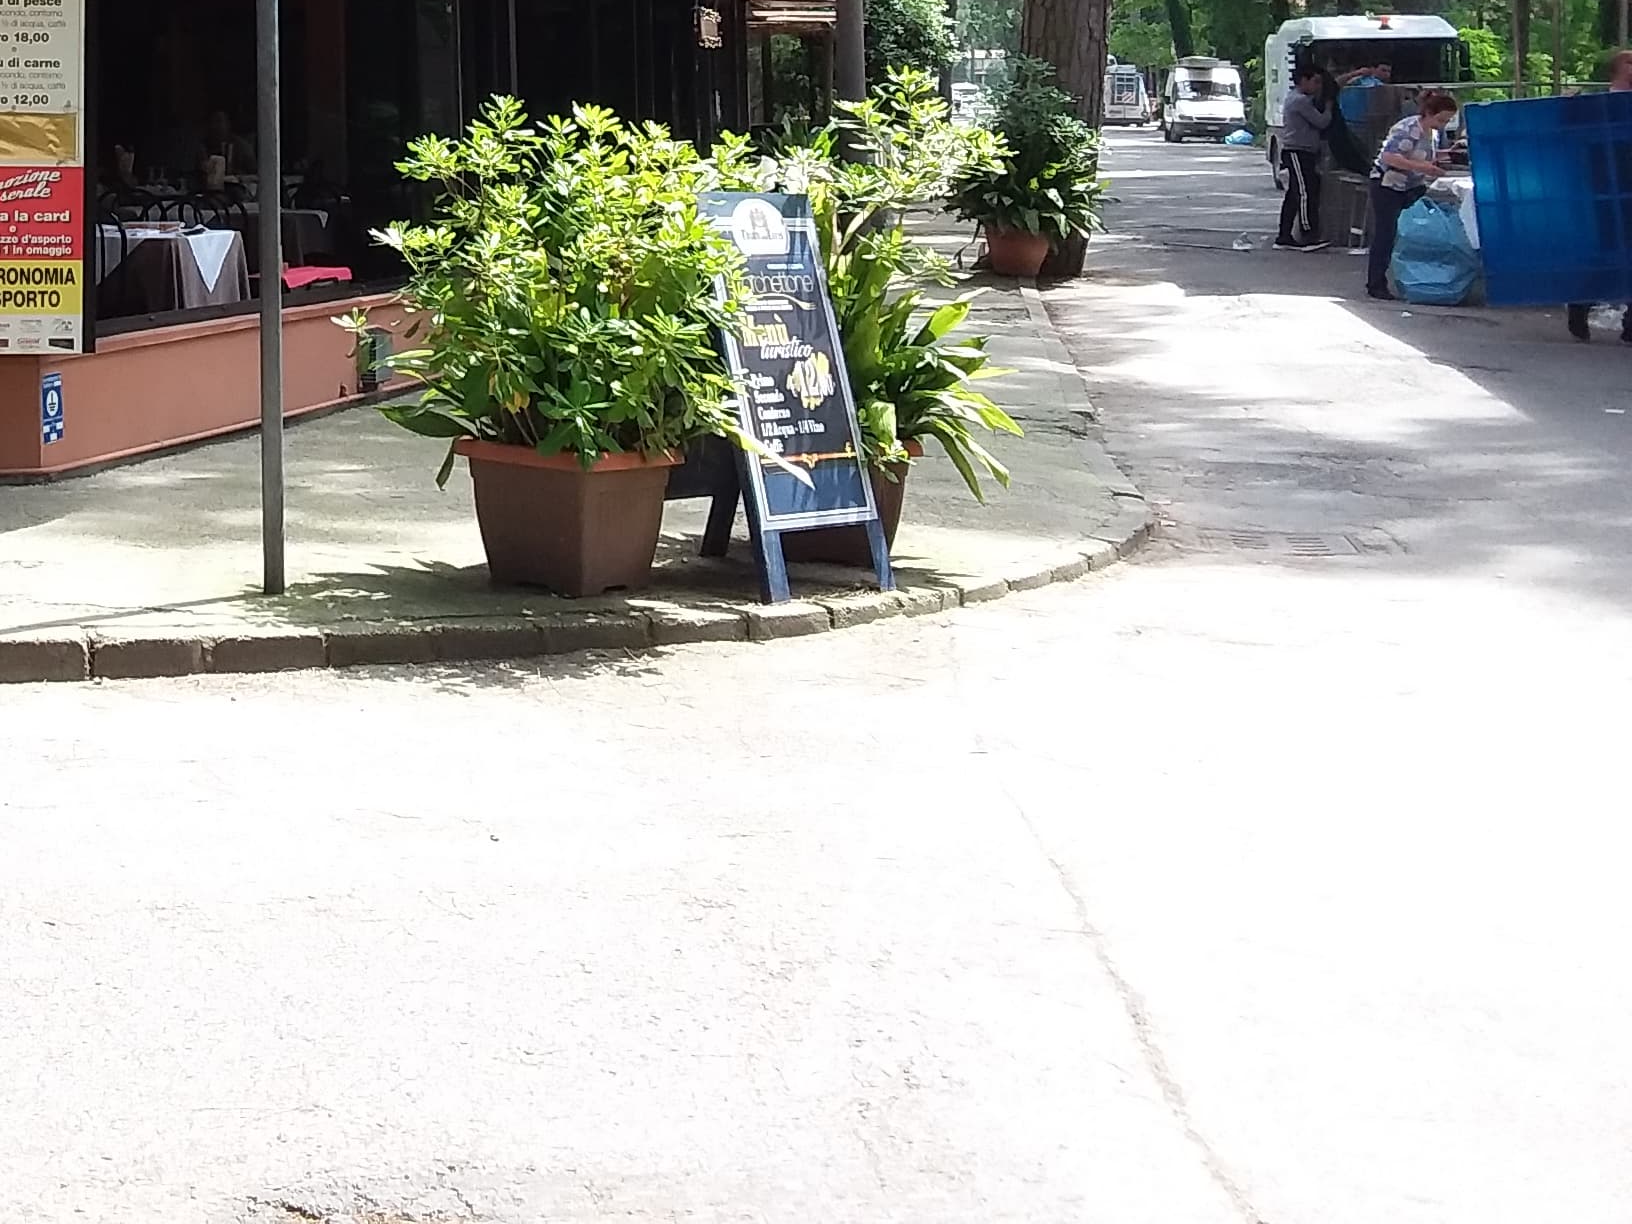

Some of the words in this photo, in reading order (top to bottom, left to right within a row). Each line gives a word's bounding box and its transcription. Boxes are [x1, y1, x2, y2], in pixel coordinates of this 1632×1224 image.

[14, 32, 50, 44] 18,00
[7, 57, 20, 68] di
[23, 59, 61, 68] carne
[13, 94, 50, 107] 12,00
[14, 209, 29, 222] la
[33, 209, 70, 222] card
[21, 234, 72, 245] d'asporto
[2, 246, 9, 255] 1
[12, 245, 23, 255] in
[25, 246, 72, 257] omaggio
